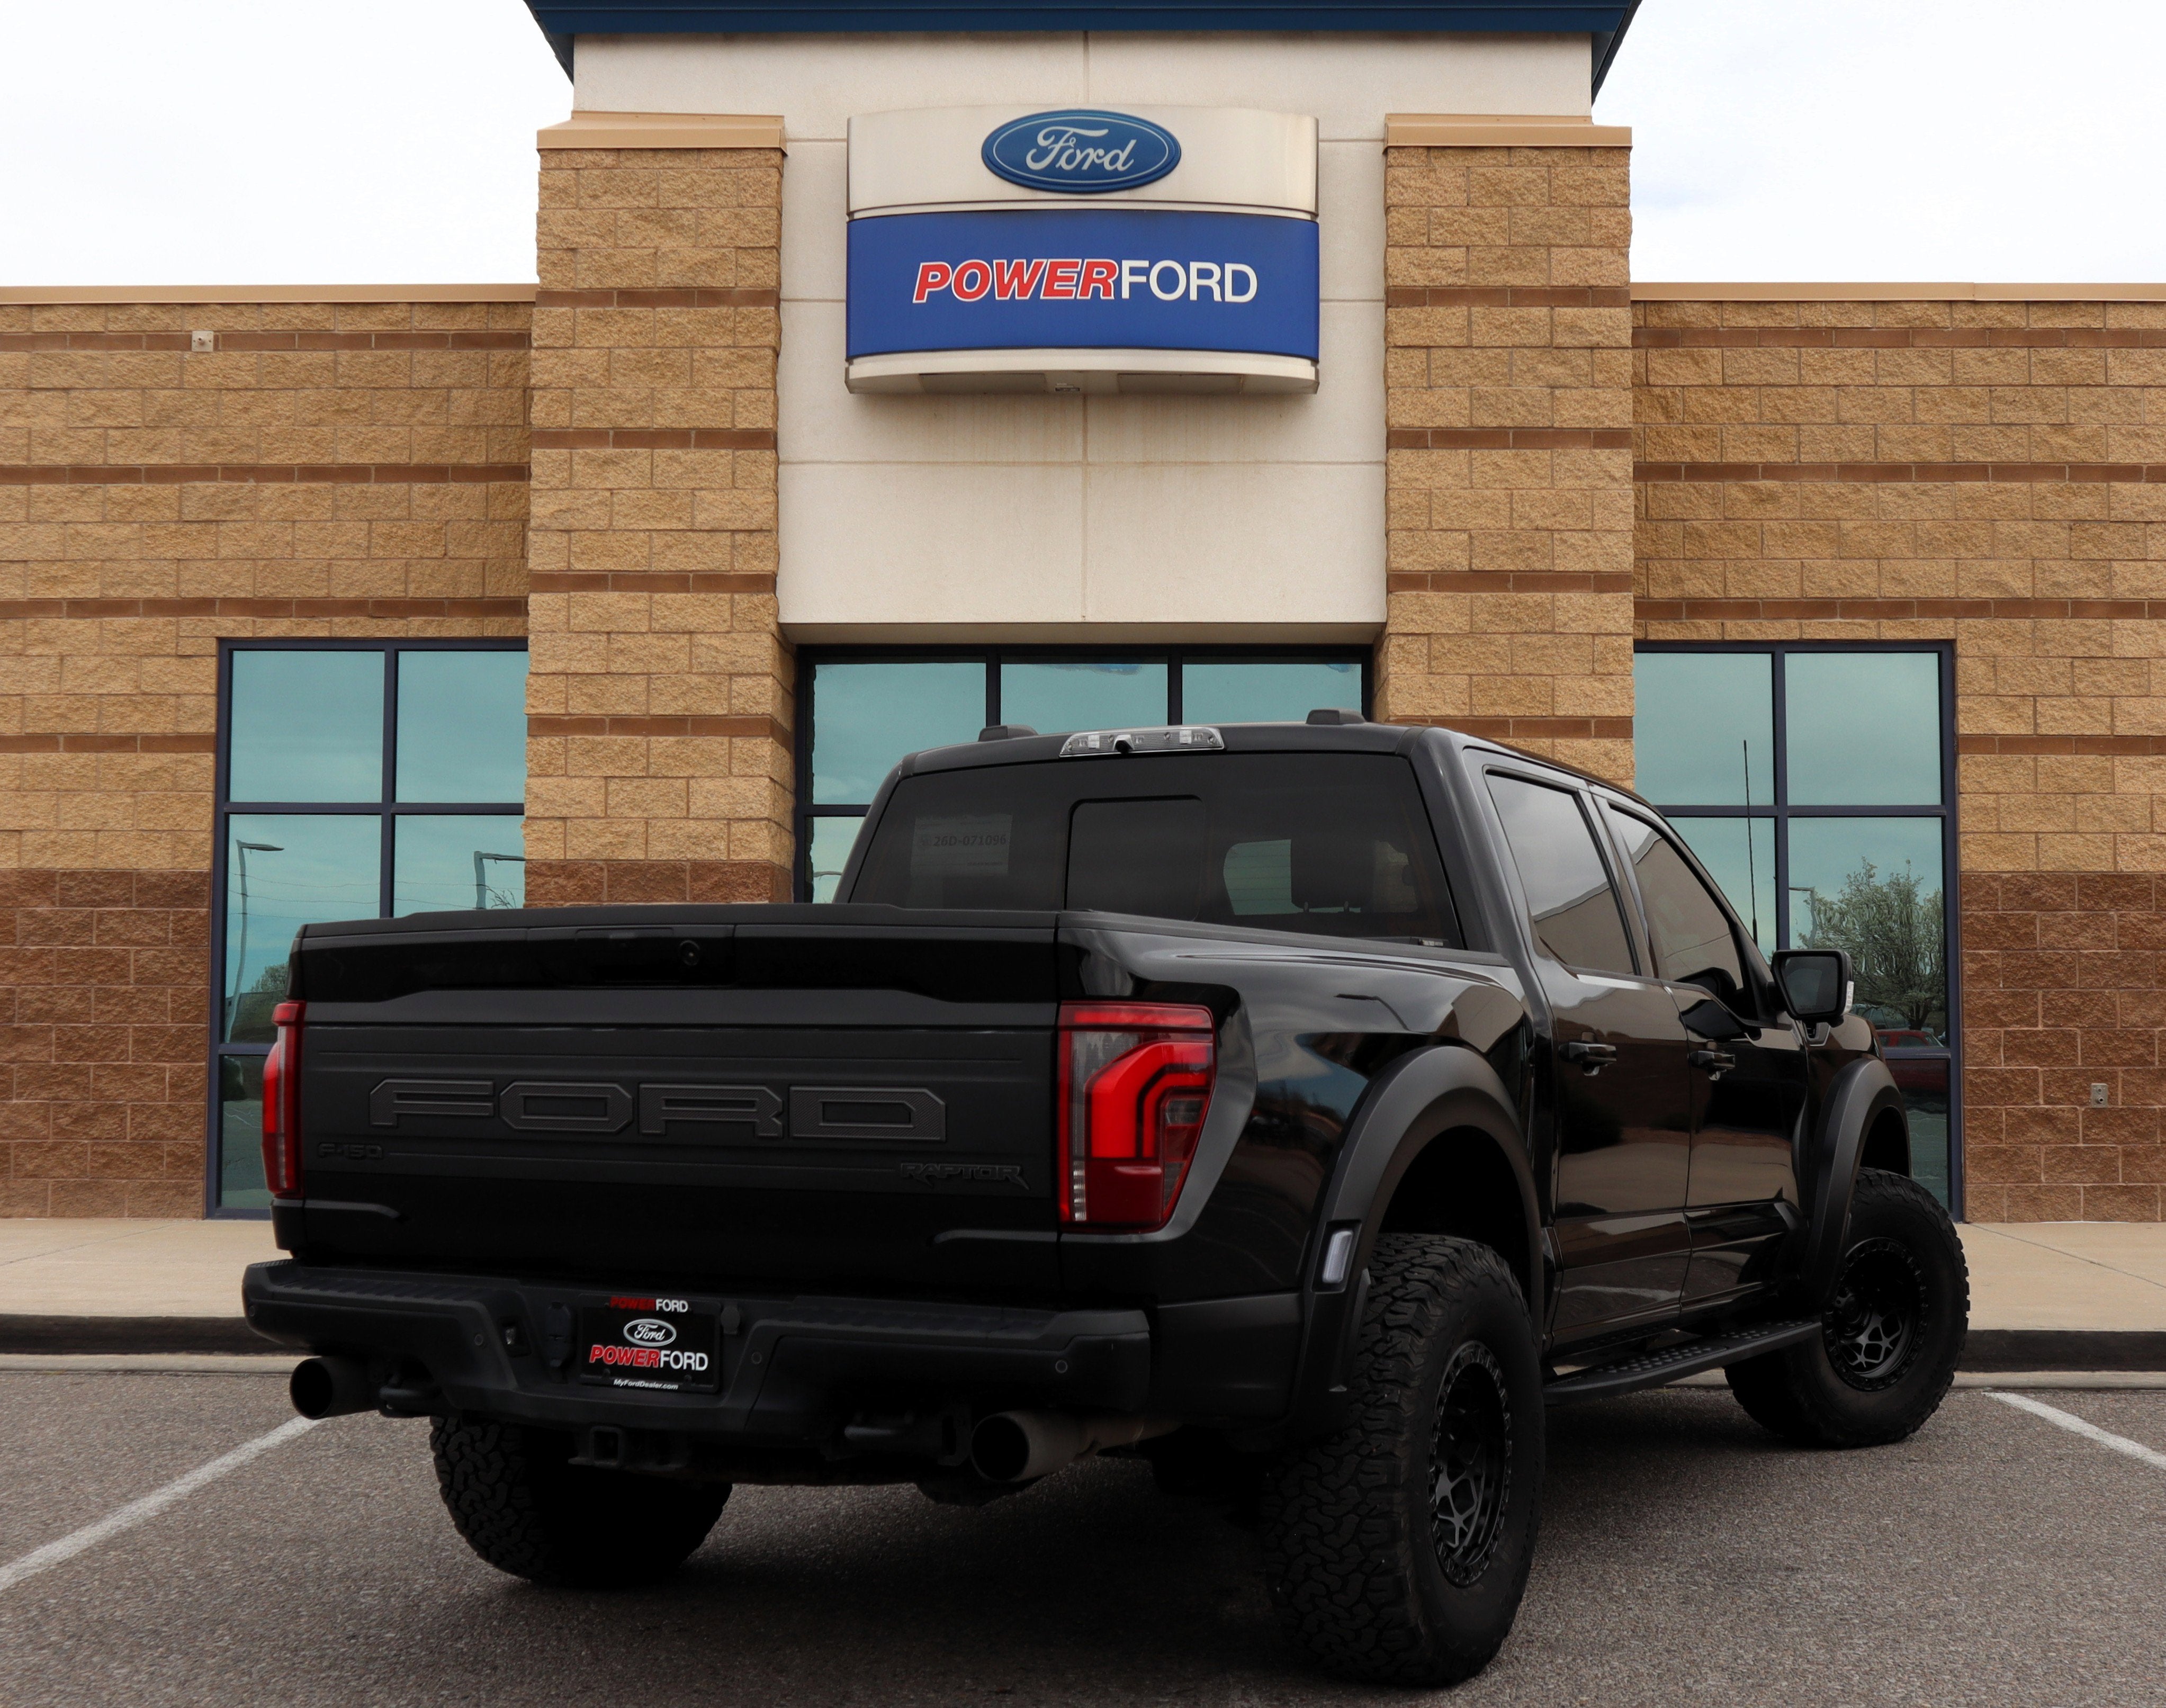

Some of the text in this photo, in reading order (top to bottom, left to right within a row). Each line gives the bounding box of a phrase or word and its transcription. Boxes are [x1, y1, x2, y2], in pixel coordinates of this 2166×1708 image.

[1026, 125, 1137, 172] Ford
[370, 1077, 946, 1142] FORD
[318, 1142, 383, 1160] F-150
[901, 1163, 1030, 1190] RAPTOR
[634, 1324, 665, 1342] Ford
[614, 1378, 678, 1390] MyFordDealer.com
